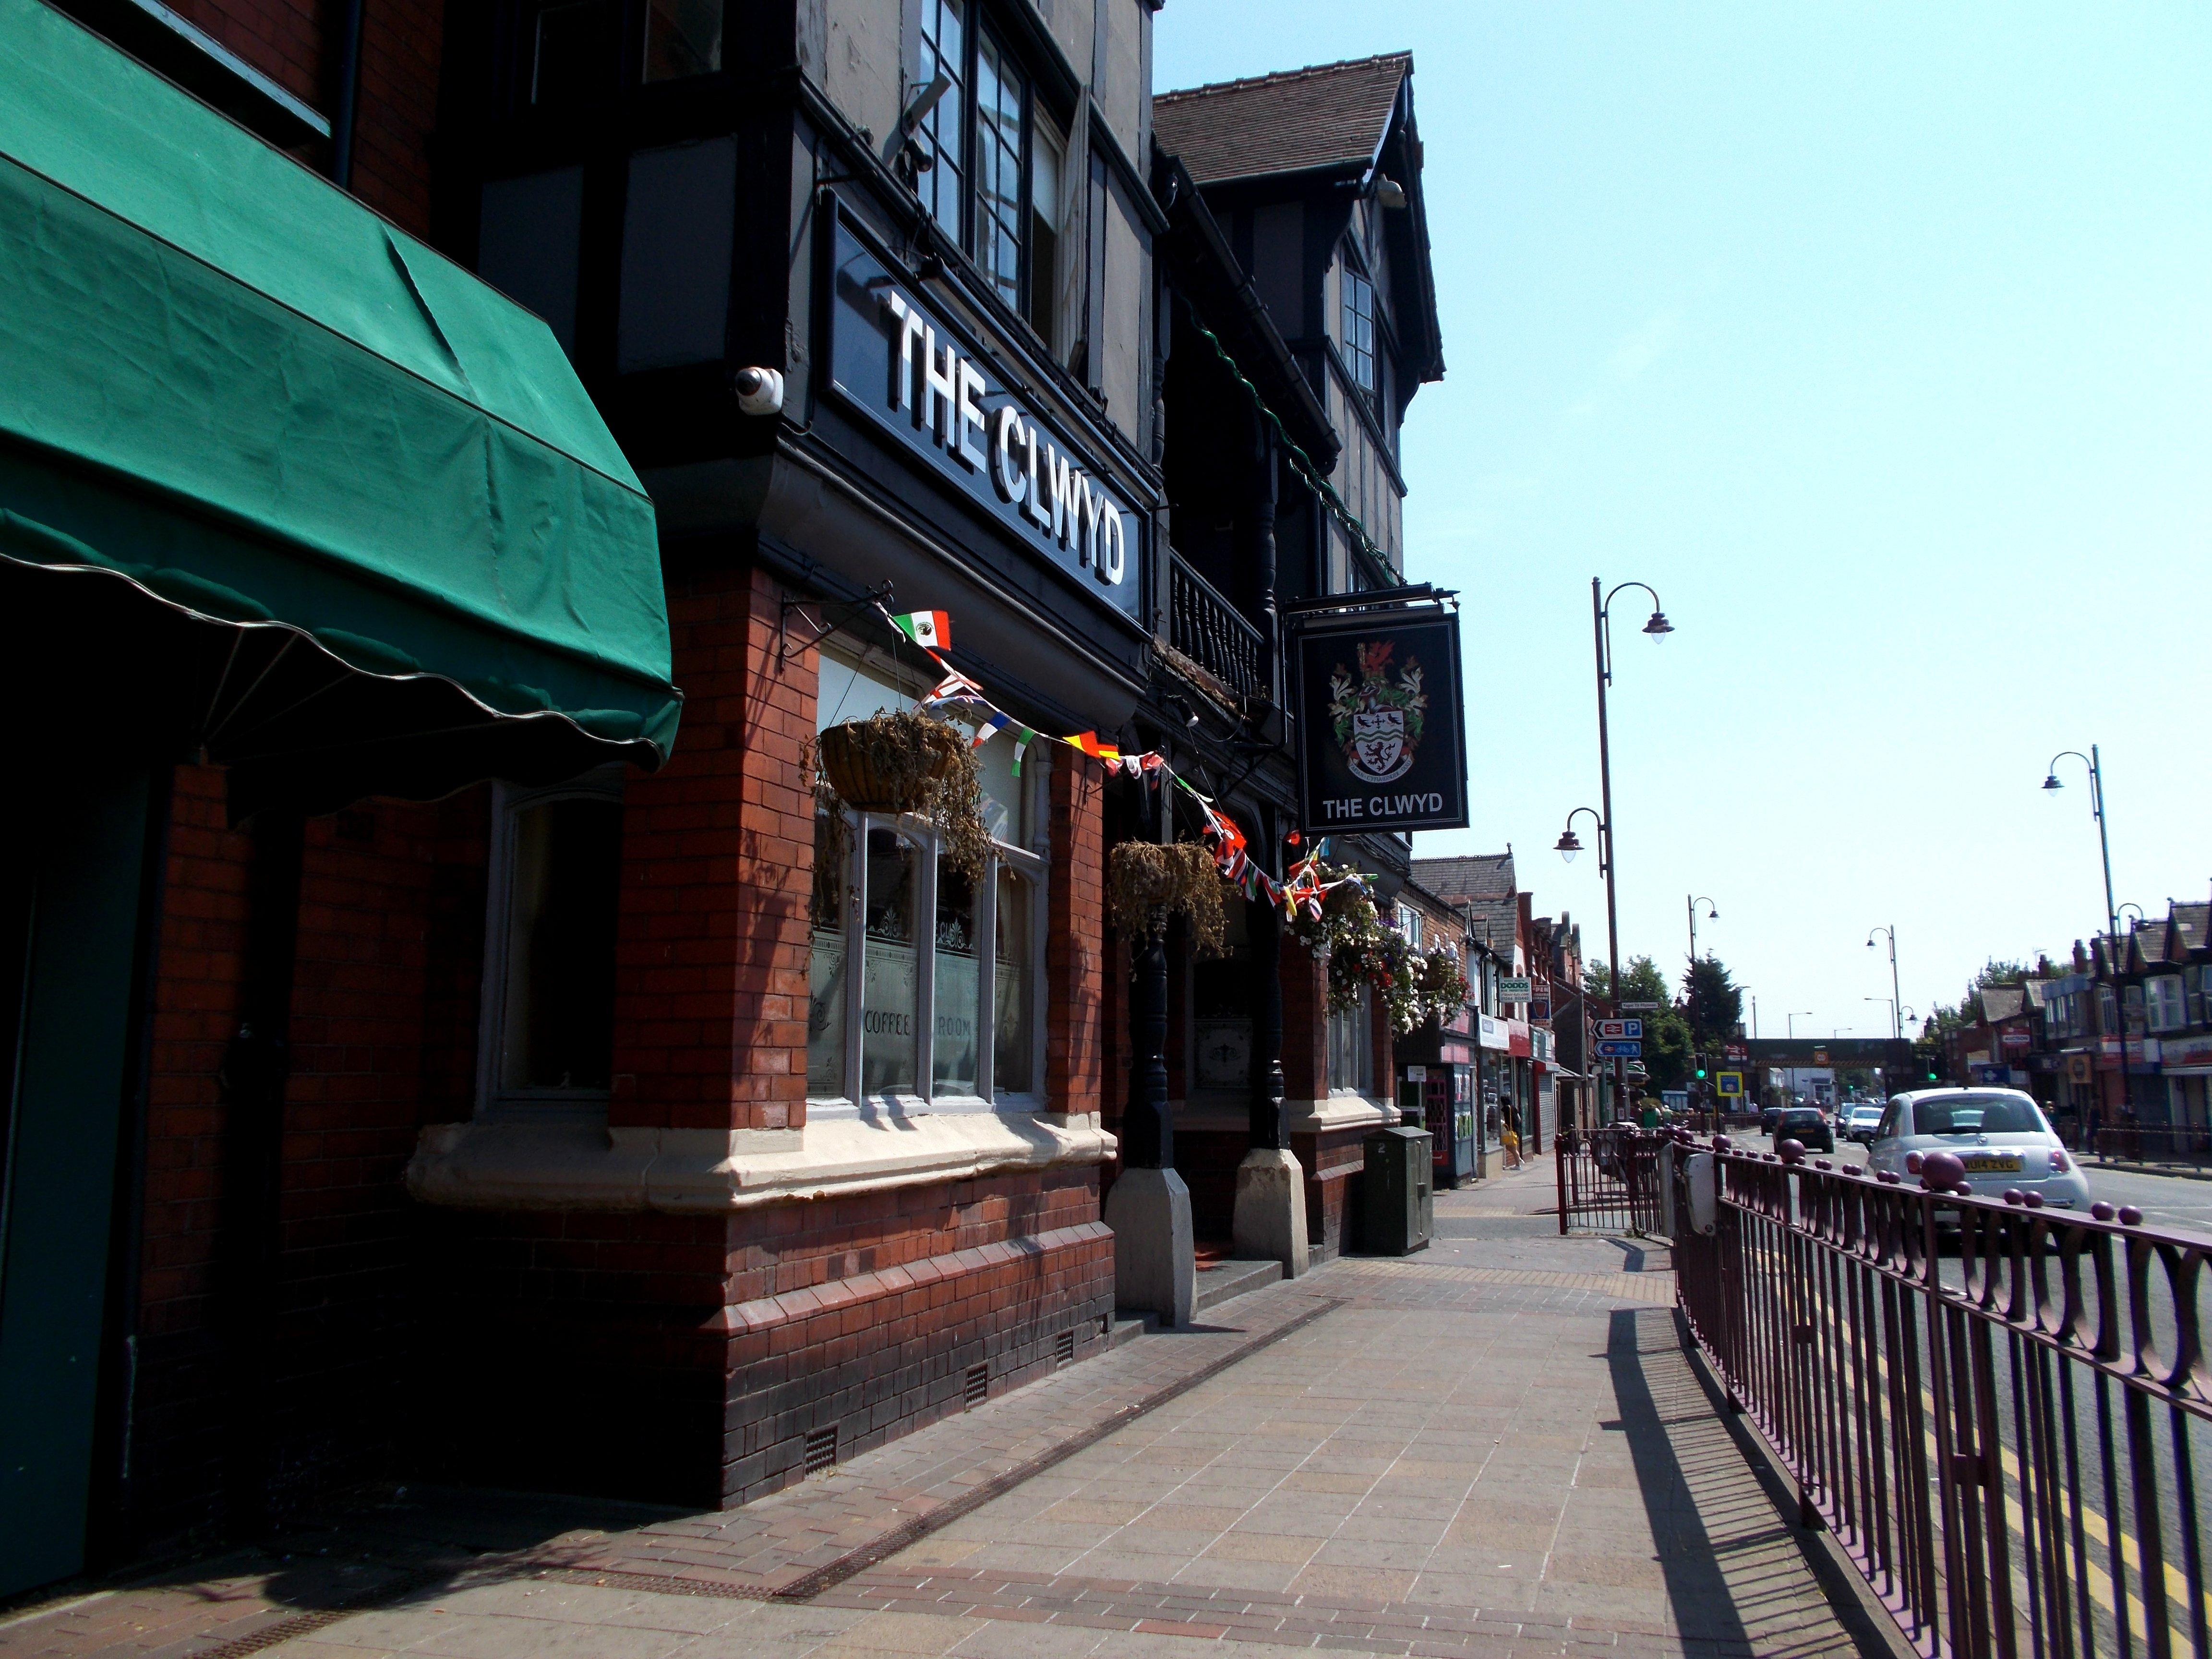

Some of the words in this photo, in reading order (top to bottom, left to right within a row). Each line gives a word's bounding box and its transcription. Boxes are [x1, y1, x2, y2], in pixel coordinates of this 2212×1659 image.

[890, 290, 986, 473] THE
[996, 406, 1125, 586] CLWYD
[1322, 798, 1363, 819] THE
[1369, 793, 1443, 816] CLWYD
[865, 1009, 911, 1036] COFFEE
[938, 1016, 971, 1036] ROOM
[1628, 1022, 1638, 1035] P
